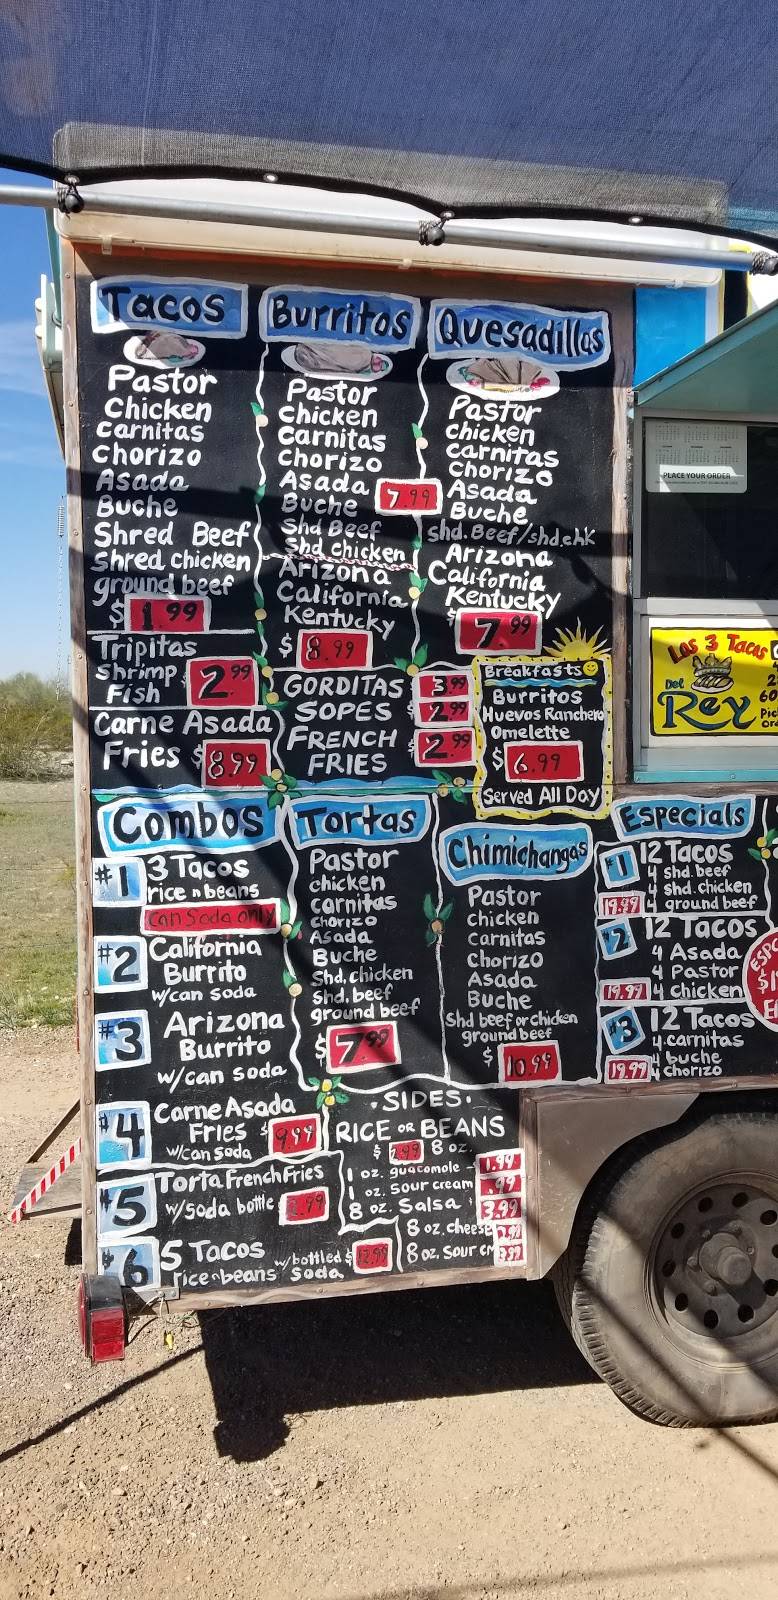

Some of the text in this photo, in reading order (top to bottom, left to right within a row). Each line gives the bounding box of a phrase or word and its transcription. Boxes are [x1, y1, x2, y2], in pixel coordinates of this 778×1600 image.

[102, 286, 225, 323] Tacos
[271, 294, 411, 340] Burritos
[436, 307, 604, 357] Quesadillas
[108, 364, 217, 395] Pastor
[287, 379, 377, 406] Pastor
[449, 394, 542, 425] Pastor
[96, 468, 189, 491] Asada
[279, 469, 370, 495] Asada
[663, 472, 731, 480] PLACE YOUR ORDER
[387, 488, 430, 508] 7.99
[446, 479, 537, 505] Asada
[96, 494, 178, 518] Buche
[281, 492, 358, 517] Buche
[450, 502, 528, 525] Buche
[94, 521, 251, 547] Shred Beef
[280, 514, 382, 541] Shd Beef
[445, 543, 553, 568] Arizona
[279, 558, 391, 584] Arizona
[428, 560, 546, 592] California
[92, 573, 234, 606] ground beef
[277, 580, 409, 608] California
[445, 586, 561, 619] Kentucky
[142, 602, 197, 630] 1.99
[284, 605, 395, 640] Kentucky
[475, 615, 531, 649] 7.99
[92, 635, 197, 667] Tripitas
[306, 635, 354, 662] 8.99
[667, 633, 768, 664] Las 3 Tacos
[199, 664, 251, 699] 2.99
[484, 663, 582, 678] Breakfasts
[107, 682, 160, 704] Fish
[284, 674, 404, 698] GORDITAS
[432, 676, 467, 696] 3.99
[665, 677, 684, 689] Del
[492, 688, 583, 705] Burritos
[294, 701, 392, 722] SOPES
[429, 702, 467, 722] 2.99
[482, 706, 541, 723] Huevos
[657, 690, 757, 731] Rey
[94, 710, 273, 736] Carne Asada
[491, 724, 571, 741] Omelette
[287, 725, 398, 751] FRENCH
[422, 733, 471, 760] 2.99
[103, 740, 180, 770] Fries
[207, 750, 257, 780] 8.99
[307, 753, 388, 776] FRIES
[513, 752, 561, 775] 6.99
[483, 785, 600, 807] Served All Day
[113, 801, 264, 844] Combos
[296, 804, 416, 836] Tortas
[620, 803, 745, 832] Especials
[310, 848, 399, 874] Pastor
[448, 833, 588, 874] Chimichangas
[640, 840, 662, 864] 12
[665, 840, 733, 863] Tacos
[148, 855, 168, 881] 3
[169, 854, 250, 880] Tacos
[696, 864, 731, 878] beef
[148, 883, 259, 903] rice beans
[468, 885, 541, 907] Pastor
[665, 895, 758, 913] ground beef
[309, 929, 374, 945] Asada
[646, 917, 671, 939] 12
[679, 916, 757, 938] Tacos
[98, 935, 262, 982] #2 California
[312, 946, 378, 966] Buche
[670, 942, 742, 961] Asada
[164, 960, 247, 985] Burrito
[468, 970, 538, 988] Asada
[672, 963, 738, 980] Pastor
[152, 986, 257, 1007] w/can soda
[352, 983, 393, 1003] beef
[468, 990, 533, 1010] Buche
[608, 984, 642, 999] 19.99
[310, 998, 420, 1026] ground beef
[445, 1008, 529, 1029] Shd beef or
[651, 1006, 756, 1032] 12 Tacos
[98, 1011, 285, 1061] #3 Arizona
[462, 1028, 552, 1047] ground beef
[180, 1036, 271, 1061] Burrito
[666, 1049, 722, 1064] buche
[158, 1062, 287, 1094] w/can soda
[611, 1062, 647, 1079] 19.99
[383, 1090, 462, 1111] SIDES
[99, 1092, 296, 1158] #4 Carne Asada
[190, 1123, 248, 1143] Fries
[336, 1116, 506, 1143] RICE OR BEANS
[167, 1143, 252, 1161] w/can soda
[431, 1139, 444, 1155] 8
[486, 1154, 514, 1171] 1.99
[154, 1170, 224, 1194] Torta
[226, 1168, 282, 1190] French
[284, 1165, 324, 1184] Fries
[432, 1179, 473, 1190] cream
[166, 1198, 231, 1224] w/soda
[237, 1194, 274, 1212] bottle
[349, 1202, 363, 1220] 8
[399, 1197, 462, 1214] Salsa
[483, 1199, 518, 1220] 3.99
[407, 1219, 420, 1236] 8
[447, 1218, 493, 1236] cheese
[161, 1239, 183, 1271] 5
[189, 1240, 266, 1264] Tacos
[274, 1250, 342, 1271] w/bottled
[407, 1242, 418, 1263] 8
[174, 1268, 277, 1287] rice beans
